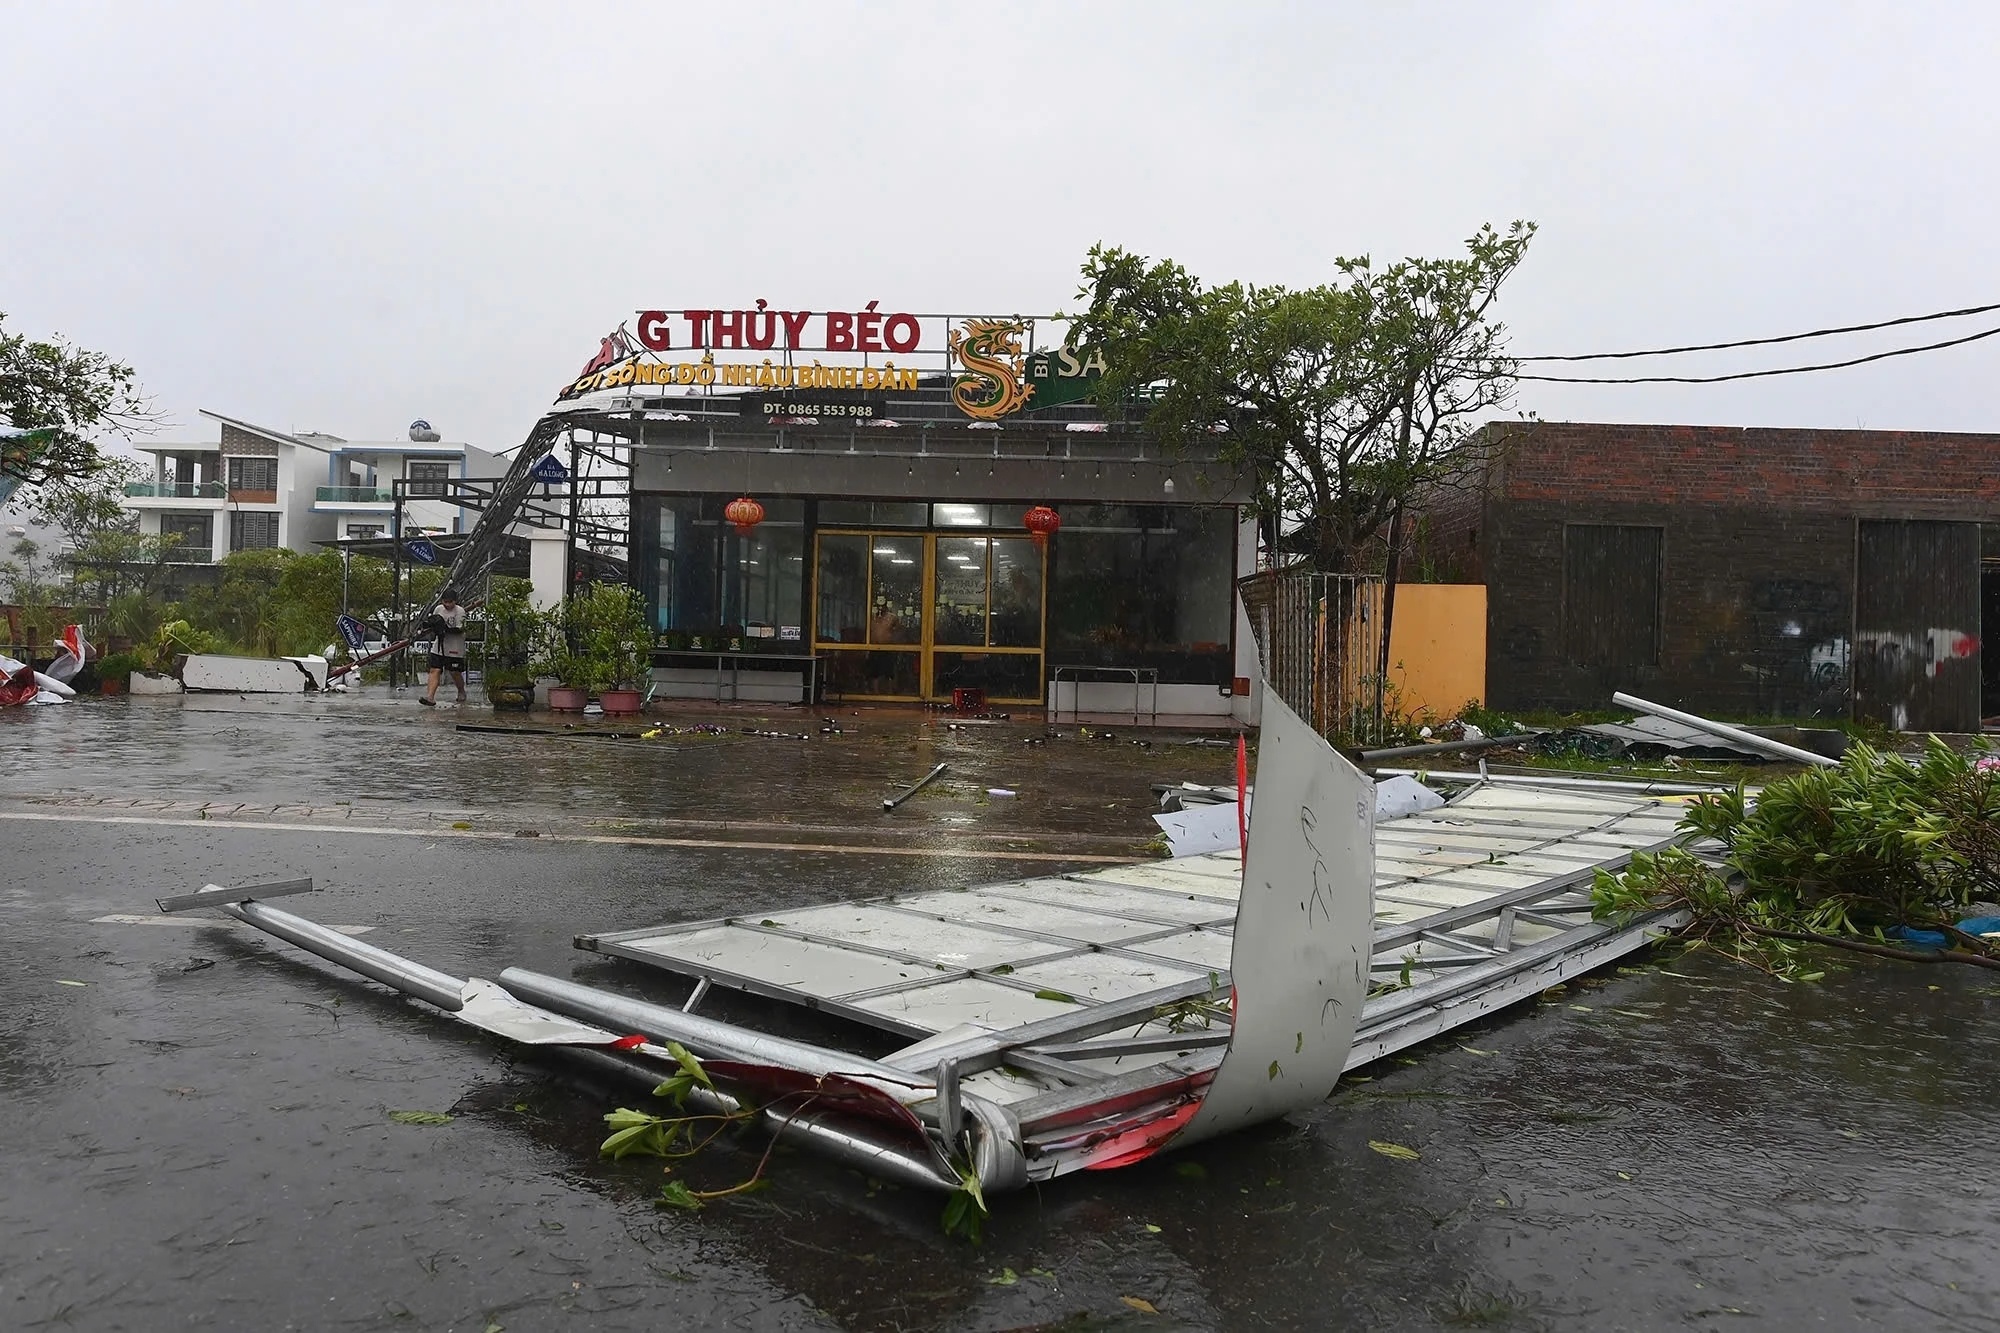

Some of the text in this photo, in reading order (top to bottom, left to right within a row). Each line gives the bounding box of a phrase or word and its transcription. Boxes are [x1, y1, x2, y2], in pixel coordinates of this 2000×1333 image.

[683, 298, 812, 351] THỦY
[826, 300, 921, 354] BÉO
[721, 358, 794, 392] NHẬU
[797, 359, 858, 389] BÌNH
[1058, 344, 1109, 378] SA
[763, 403, 873, 417] ĐT: 0865 553 988
